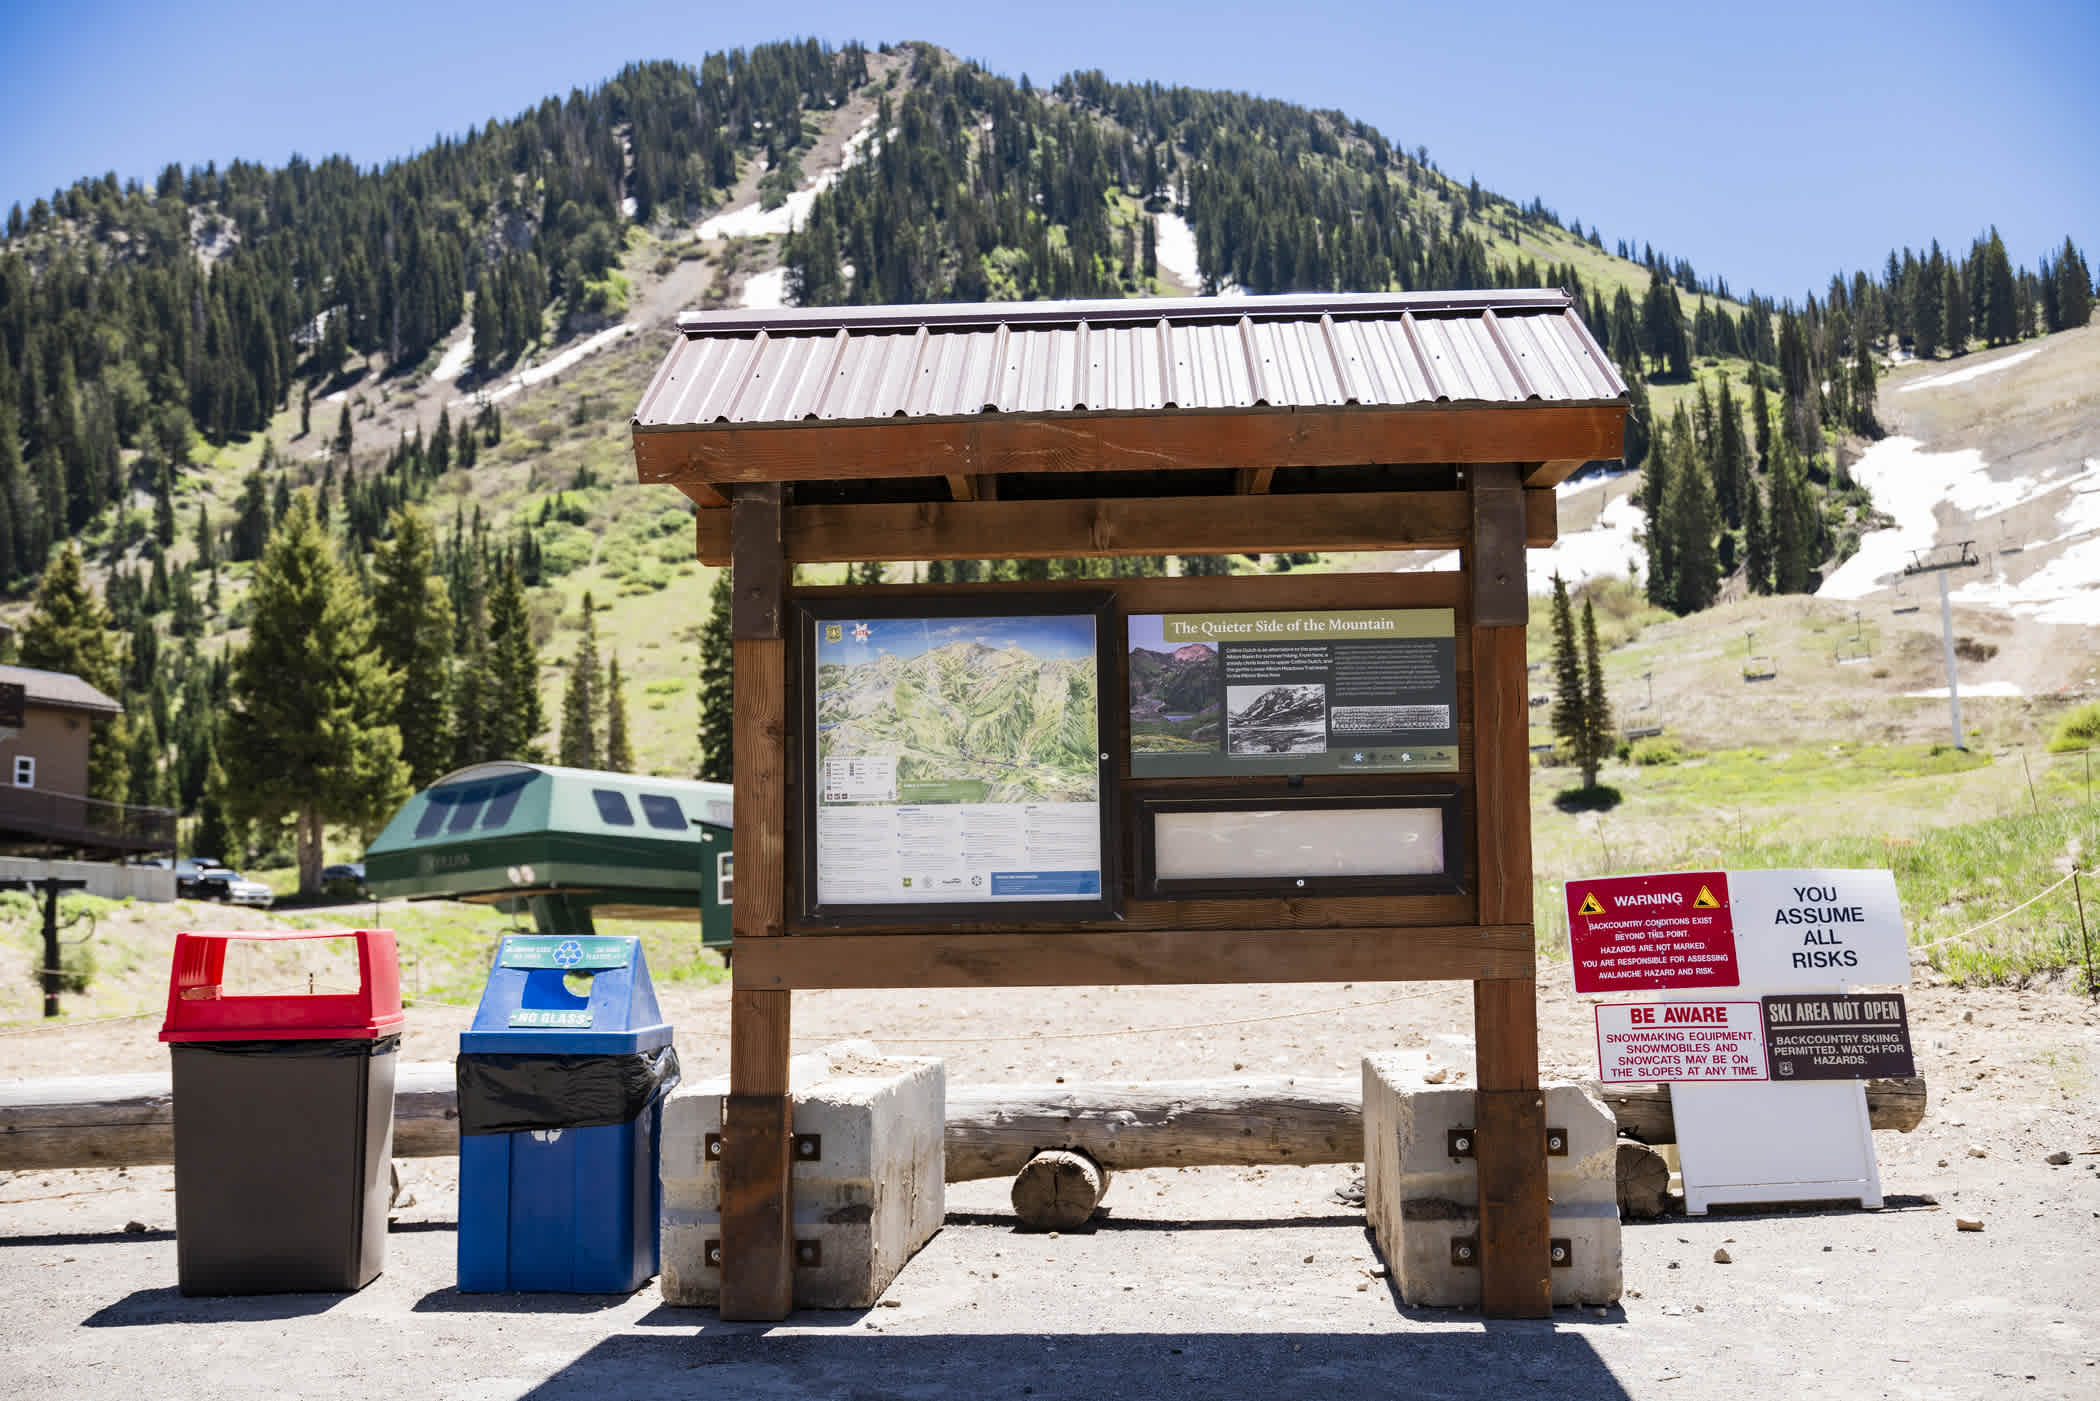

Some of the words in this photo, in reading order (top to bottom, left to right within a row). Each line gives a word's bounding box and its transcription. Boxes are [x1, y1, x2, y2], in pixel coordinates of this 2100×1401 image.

[1173, 621, 1199, 634] The
[1201, 621, 1253, 636] Quieter
[1256, 620, 1283, 632] Side
[1286, 619, 1301, 631] of
[1304, 619, 1325, 631] the
[1328, 618, 1394, 631] Mountain
[1614, 892, 1683, 907] WARNING
[1793, 886, 1837, 902] YOU
[1775, 907, 1864, 924] ASSUME
[1589, 920, 1642, 930] BACKCOUNTRY
[1646, 918, 1689, 927] CONDITIONS
[1616, 932, 1645, 941] BEYOND
[1648, 931, 1664, 939] THIS
[1804, 929, 1842, 945] ALL
[1601, 945, 1636, 954] HAZARDS
[1639, 944, 1654, 952] ARE
[1582, 960, 1597, 968] YOU
[1618, 957, 1667, 966] RESPONSIBLE
[1670, 956, 1684, 964] FOR
[1688, 954, 1728, 962] ASSESSING
[1792, 950, 1858, 968] RISKS
[1599, 971, 1642, 980] AVALANCHE
[1644, 969, 1675, 977] HAZARD
[1630, 1008, 1656, 1024] BE
[1664, 1007, 1728, 1023] AWARE
[1769, 1003, 1792, 1022] SKI
[1796, 1002, 1830, 1022] AREA
[1833, 1002, 1861, 1020] NOT
[1864, 1001, 1900, 1020] OPEN
[518, 1012, 538, 1023] NO
[541, 1013, 586, 1024] GLASS
[1606, 1032, 1684, 1043] SNOWMAKING
[1776, 1035, 1859, 1045] BACKCOUNTRY
[1862, 1034, 1899, 1043] SKIING
[1626, 1044, 1710, 1054] SNOWMOBILES
[1715, 1044, 1738, 1052] AND
[1774, 1046, 1838, 1056] PERMITTED.
[1841, 1045, 1880, 1054] WATCH
[1882, 1044, 1904, 1053] FOR
[1618, 1056, 1680, 1065] SNOWCATS
[1686, 1056, 1708, 1064] MAY
[1713, 1055, 1726, 1064] BE
[1732, 1055, 1749, 1063] ON
[1813, 1056, 1868, 1064] HAZARDS.
[1610, 1068, 1632, 1077] THE
[1638, 1067, 1682, 1077] SLOPES
[1688, 1067, 1700, 1075] AT
[1705, 1066, 1728, 1076] ANY
[1731, 1066, 1758, 1075] TIME
